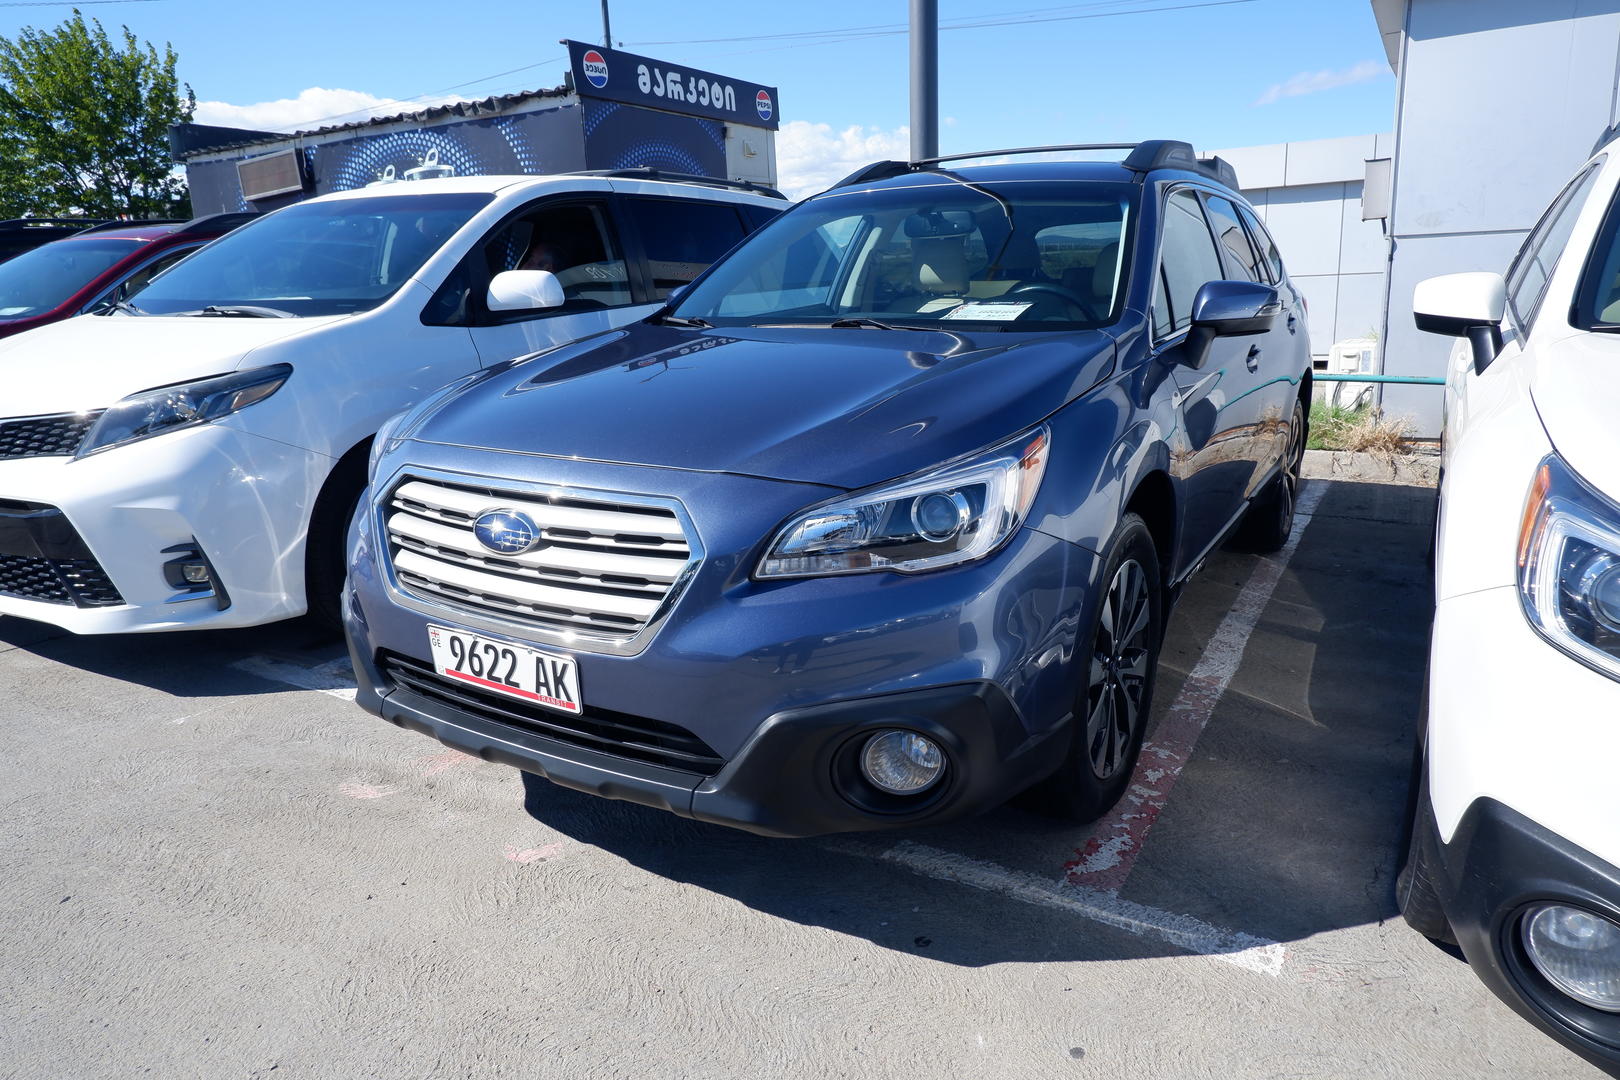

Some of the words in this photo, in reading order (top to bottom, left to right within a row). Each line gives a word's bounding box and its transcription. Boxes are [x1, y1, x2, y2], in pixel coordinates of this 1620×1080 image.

[637, 64, 737, 112] მარკეტი
[757, 101, 771, 110] PEPSI
[431, 638, 442, 648] GE
[449, 635, 520, 689] 9622
[535, 656, 573, 702] AK
[537, 694, 567, 708] TRANSIT
